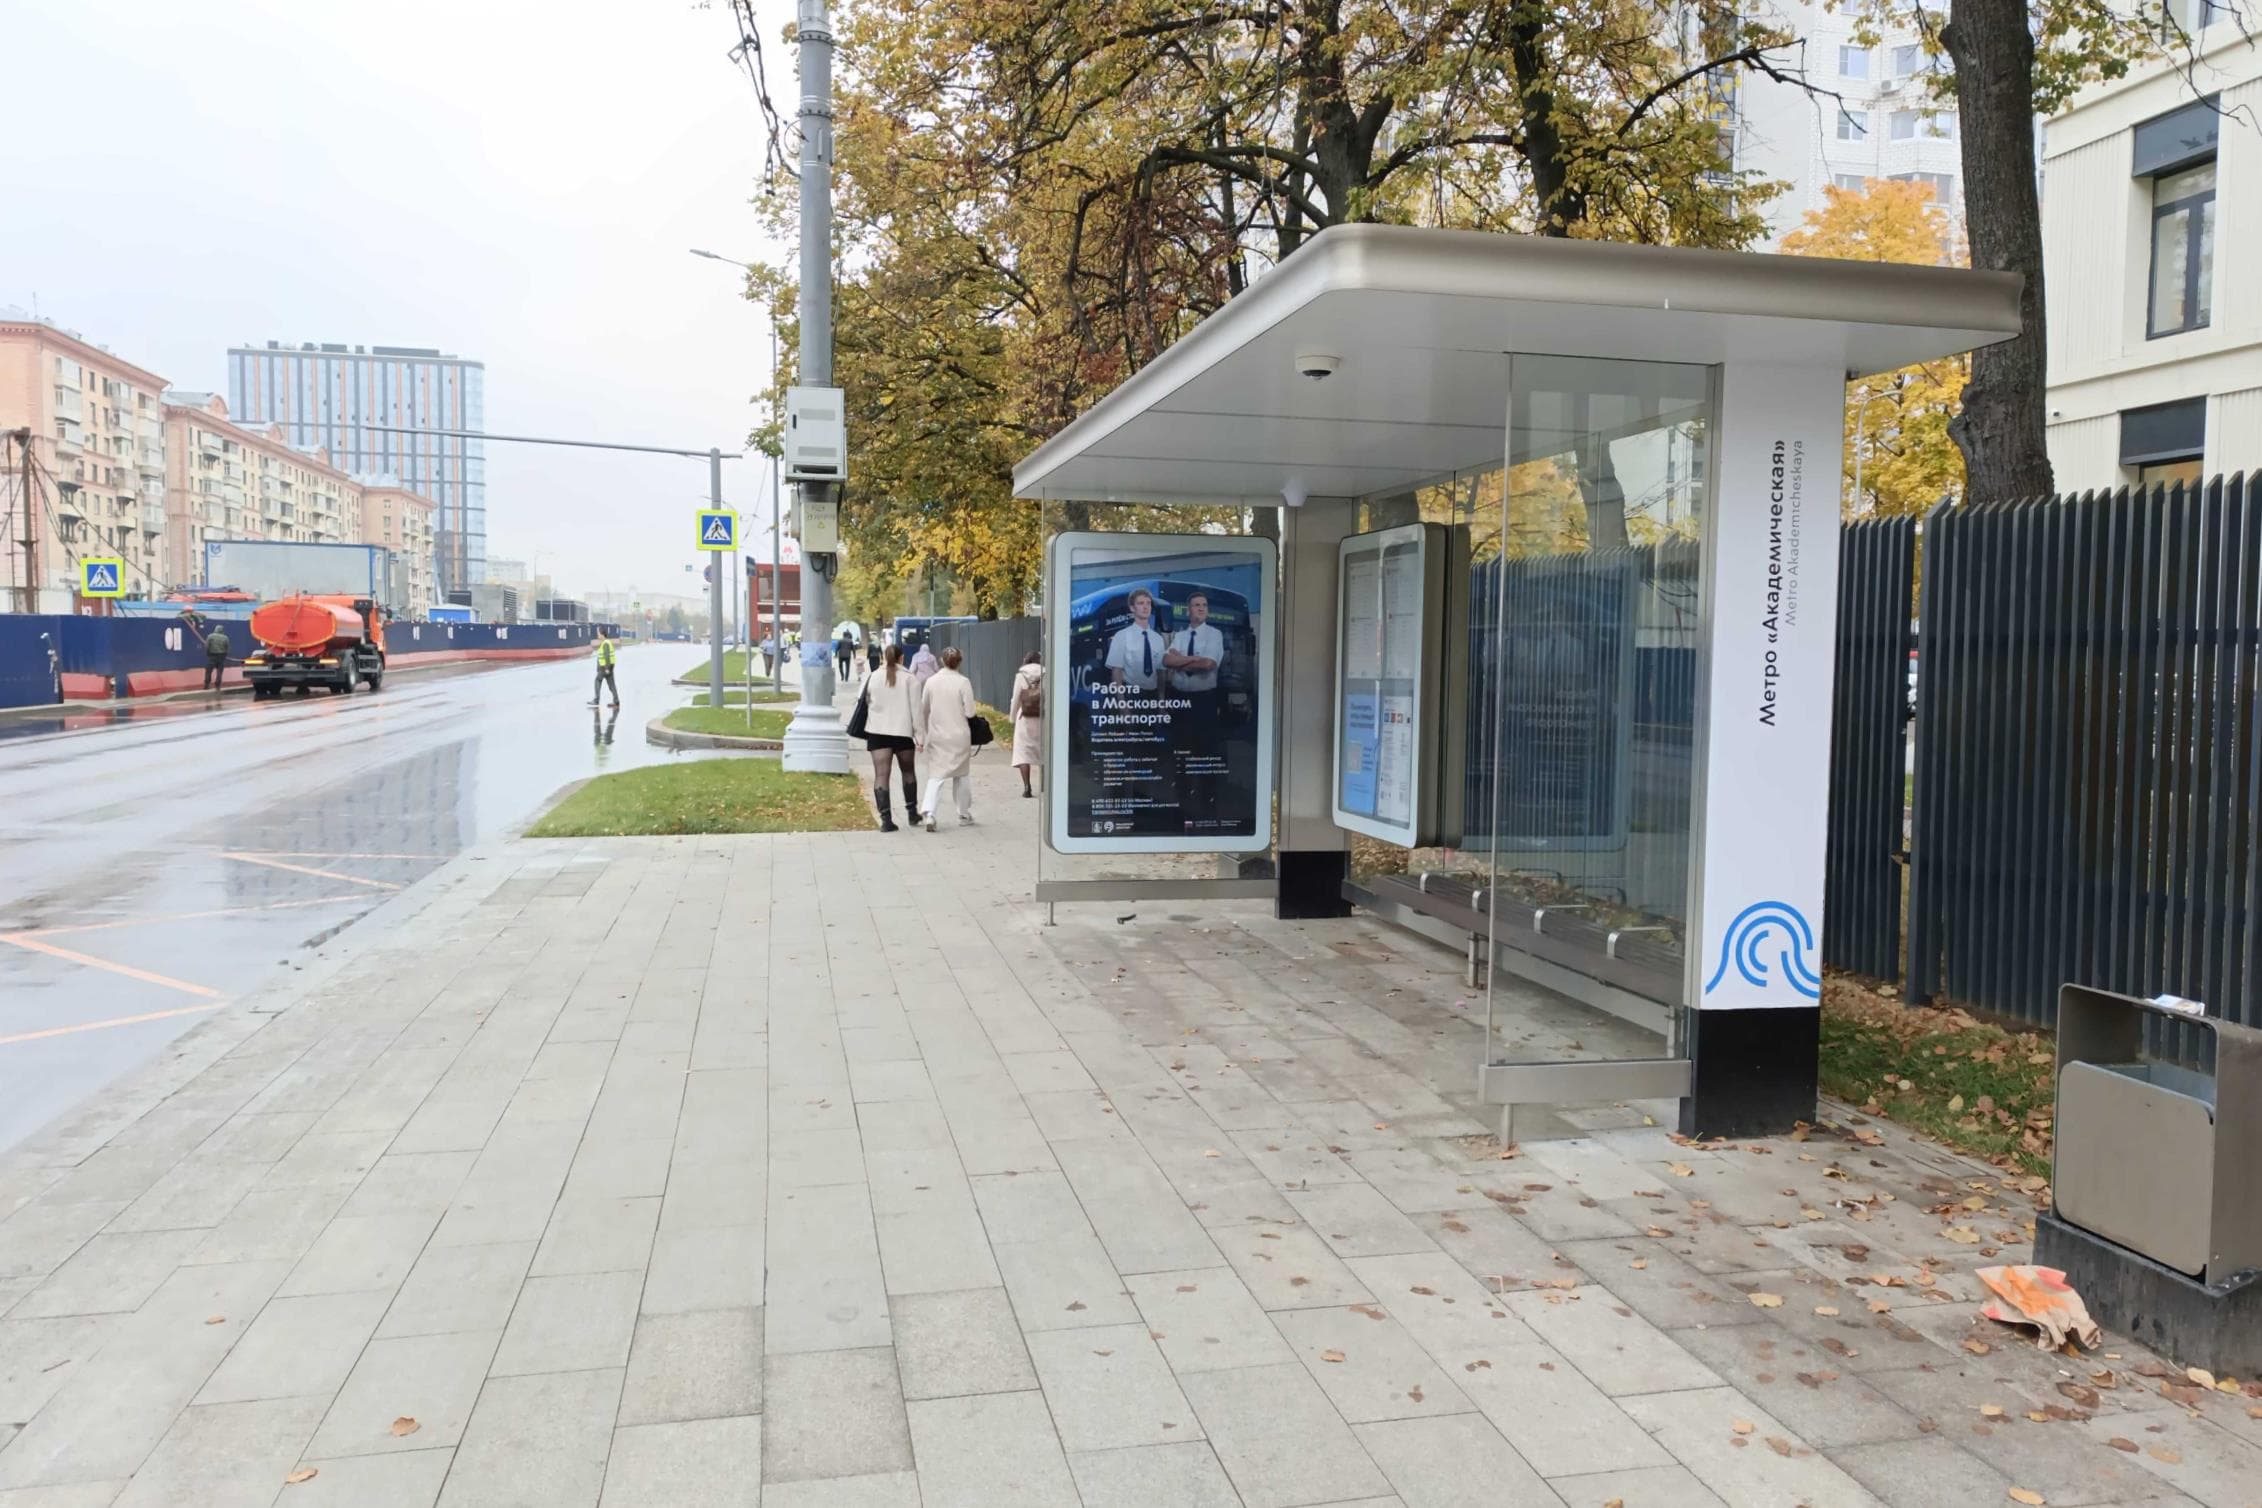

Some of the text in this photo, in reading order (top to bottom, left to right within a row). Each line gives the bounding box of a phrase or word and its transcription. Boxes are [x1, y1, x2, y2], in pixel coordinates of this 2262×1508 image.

[1785, 440, 1805, 626] Metro Akademicheskaya
[1759, 440, 1785, 726] Метро «Академическая»
[1092, 681, 1140, 694] Работа
[1092, 697, 1192, 709] в Московском
[1091, 714, 1172, 727] транспорте
